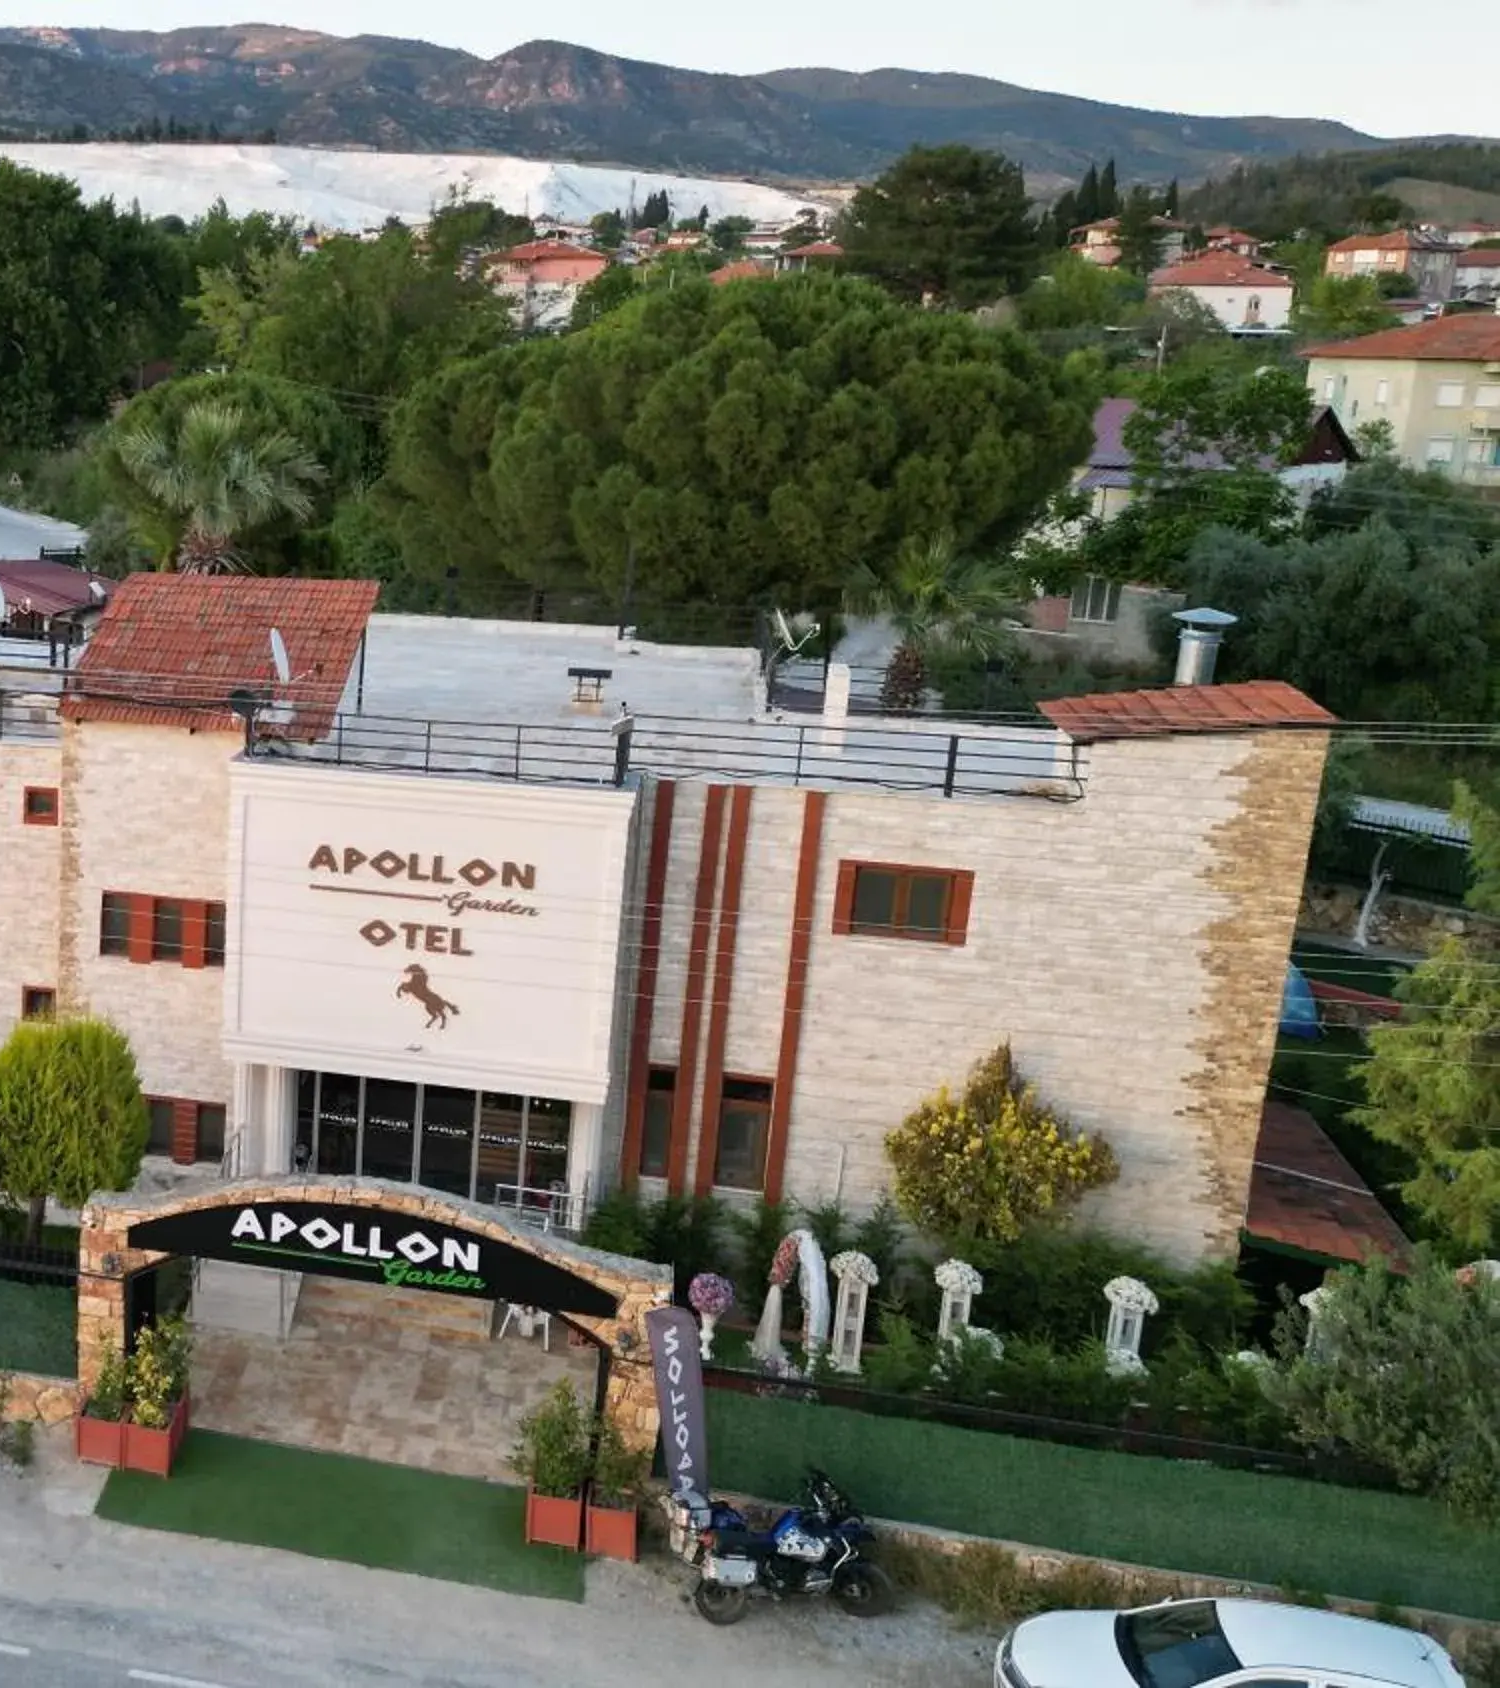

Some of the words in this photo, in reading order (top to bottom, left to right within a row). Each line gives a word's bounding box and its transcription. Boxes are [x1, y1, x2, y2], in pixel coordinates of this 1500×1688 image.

[308, 844, 536, 890] APOLLON
[442, 890, 540, 916] Garden
[359, 919, 475, 956] OTEL
[231, 1209, 480, 1272] APOLLON
[380, 1259, 486, 1289] Garden
